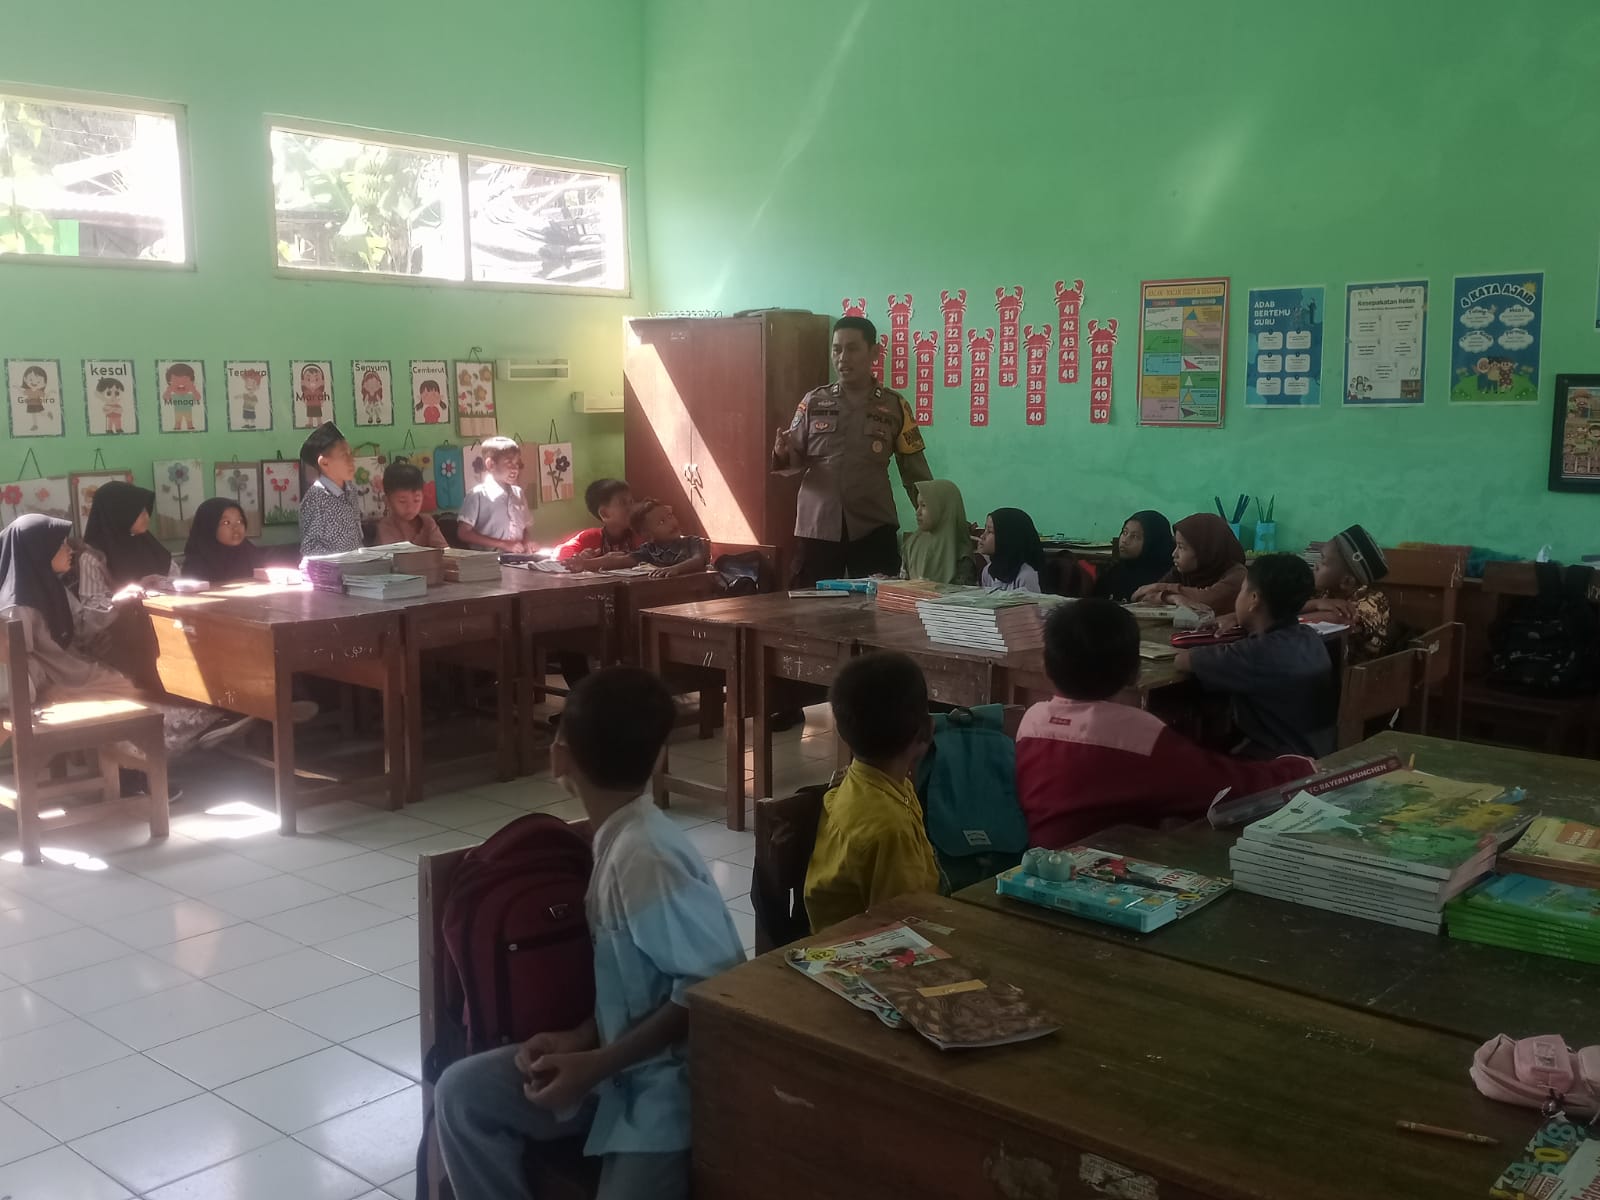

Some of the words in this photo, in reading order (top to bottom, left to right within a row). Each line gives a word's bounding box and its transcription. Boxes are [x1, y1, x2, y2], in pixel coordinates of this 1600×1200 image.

[1469, 283, 1500, 302] KATA
[1502, 284, 1535, 305] AJAIB
[1063, 304, 1074, 315] 41
[1254, 300, 1275, 309] ADAB
[948, 312, 958, 324] 21
[1004, 309, 1015, 320] 31
[1254, 309, 1291, 317] BERTEMU
[896, 315, 904, 325] 11
[1062, 320, 1075, 331] 42
[1254, 318, 1275, 326] GURU
[895, 331, 905, 341] 12
[946, 327, 959, 338] 22
[1003, 325, 1015, 336] 32
[1002, 341, 1015, 352] 33
[1062, 336, 1075, 348] 43
[895, 346, 905, 356] 13
[947, 343, 959, 354] 23
[1031, 348, 1044, 359] 36
[1095, 343, 1109, 355] 46
[920, 353, 930, 363] 16
[947, 356, 959, 367] 24
[974, 351, 986, 362] 26
[1002, 355, 1015, 366] 34
[1062, 351, 1075, 362] 44
[90, 363, 127, 376] kesal
[355, 363, 388, 373] Senyum
[895, 359, 905, 369] 14
[1030, 364, 1043, 375] 37
[1095, 360, 1108, 371] 47
[412, 366, 445, 374] Cemberut
[920, 368, 930, 378] 17
[974, 367, 986, 377] 27
[1061, 368, 1075, 379] 45
[895, 375, 905, 385] 15
[947, 373, 959, 384] 25
[1002, 372, 1014, 383] 35
[1094, 376, 1108, 387] 48
[919, 382, 929, 392] 18
[973, 382, 986, 393] 28
[1029, 380, 1043, 391] 38
[295, 391, 330, 402] Marah
[973, 396, 985, 406] 29
[1029, 393, 1042, 404] 39
[1094, 390, 1108, 401] 49
[919, 396, 929, 407] 19
[918, 412, 930, 422] 20
[973, 413, 985, 423] 30
[1029, 411, 1042, 422] 40
[1094, 408, 1107, 419] 50
[1319, 777, 1349, 791] BAYERN
